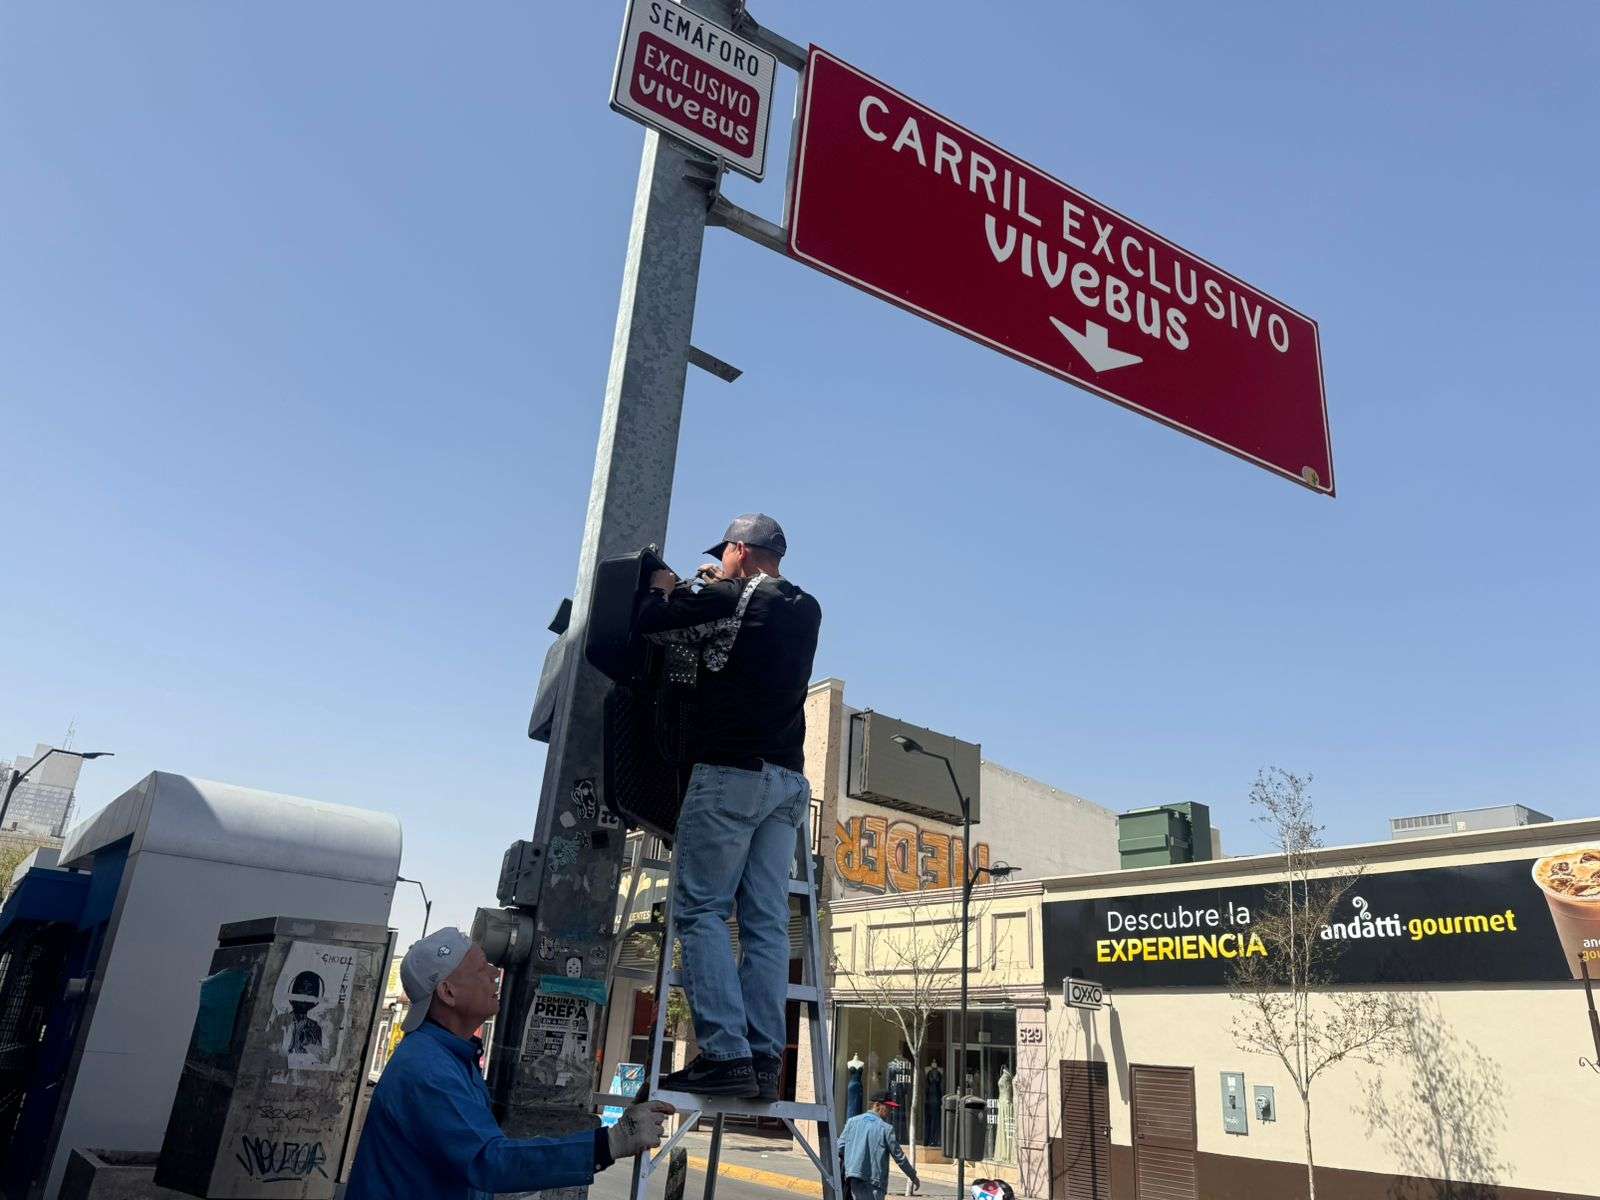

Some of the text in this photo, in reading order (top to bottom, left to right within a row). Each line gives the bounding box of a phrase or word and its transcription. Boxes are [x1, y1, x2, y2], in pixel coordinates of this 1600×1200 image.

[650, 2, 759, 77] SEMÁFORO
[644, 44, 750, 117] EXCLUSIVO
[859, 95, 1289, 353] CARRIL EXCLUSIVO
[1107, 901, 1250, 932] Descubre la
[1096, 932, 1268, 963] EXPERIENCIA
[536, 995, 576, 1006] TERMINA
[1072, 985, 1102, 1003] OXXO
[1019, 1027, 1043, 1044] 529
